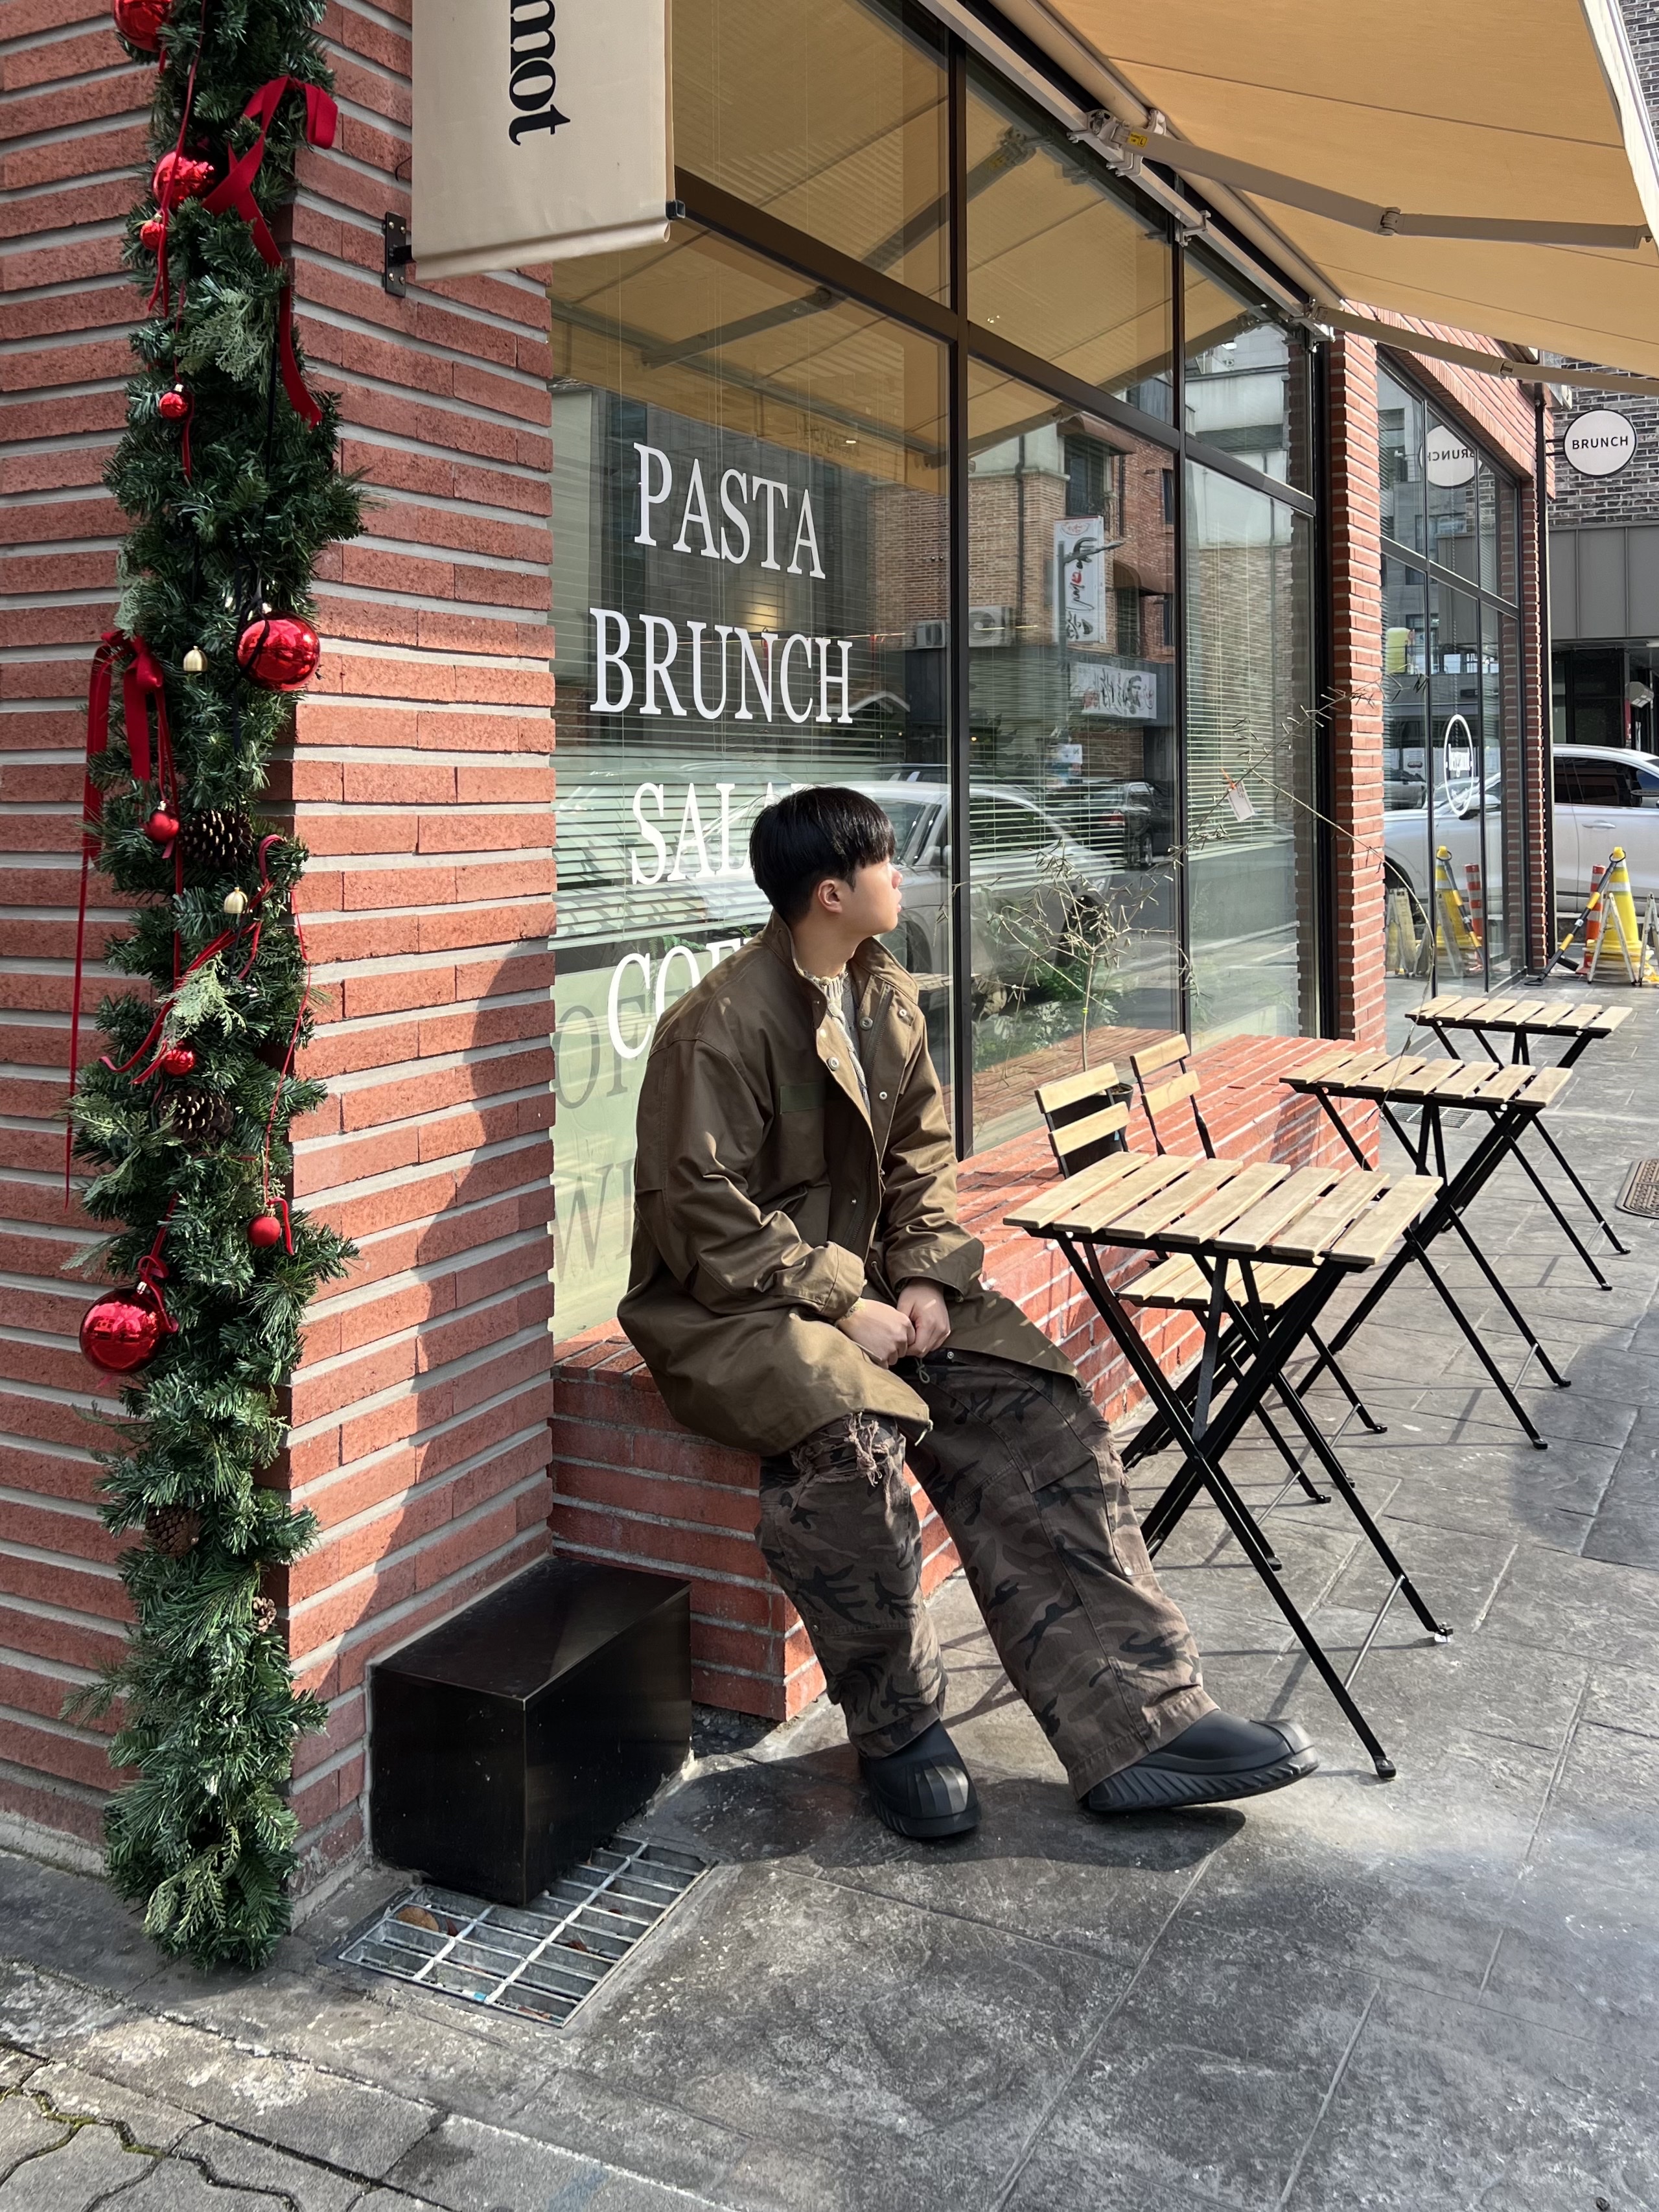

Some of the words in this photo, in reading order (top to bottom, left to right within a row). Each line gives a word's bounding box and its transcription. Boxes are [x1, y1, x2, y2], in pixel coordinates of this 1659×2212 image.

[1572, 436, 1628, 450] BRUNCH
[634, 442, 826, 579] PASTA
[590, 607, 853, 724] BRUNCH
[631, 782, 802, 885] SAL
